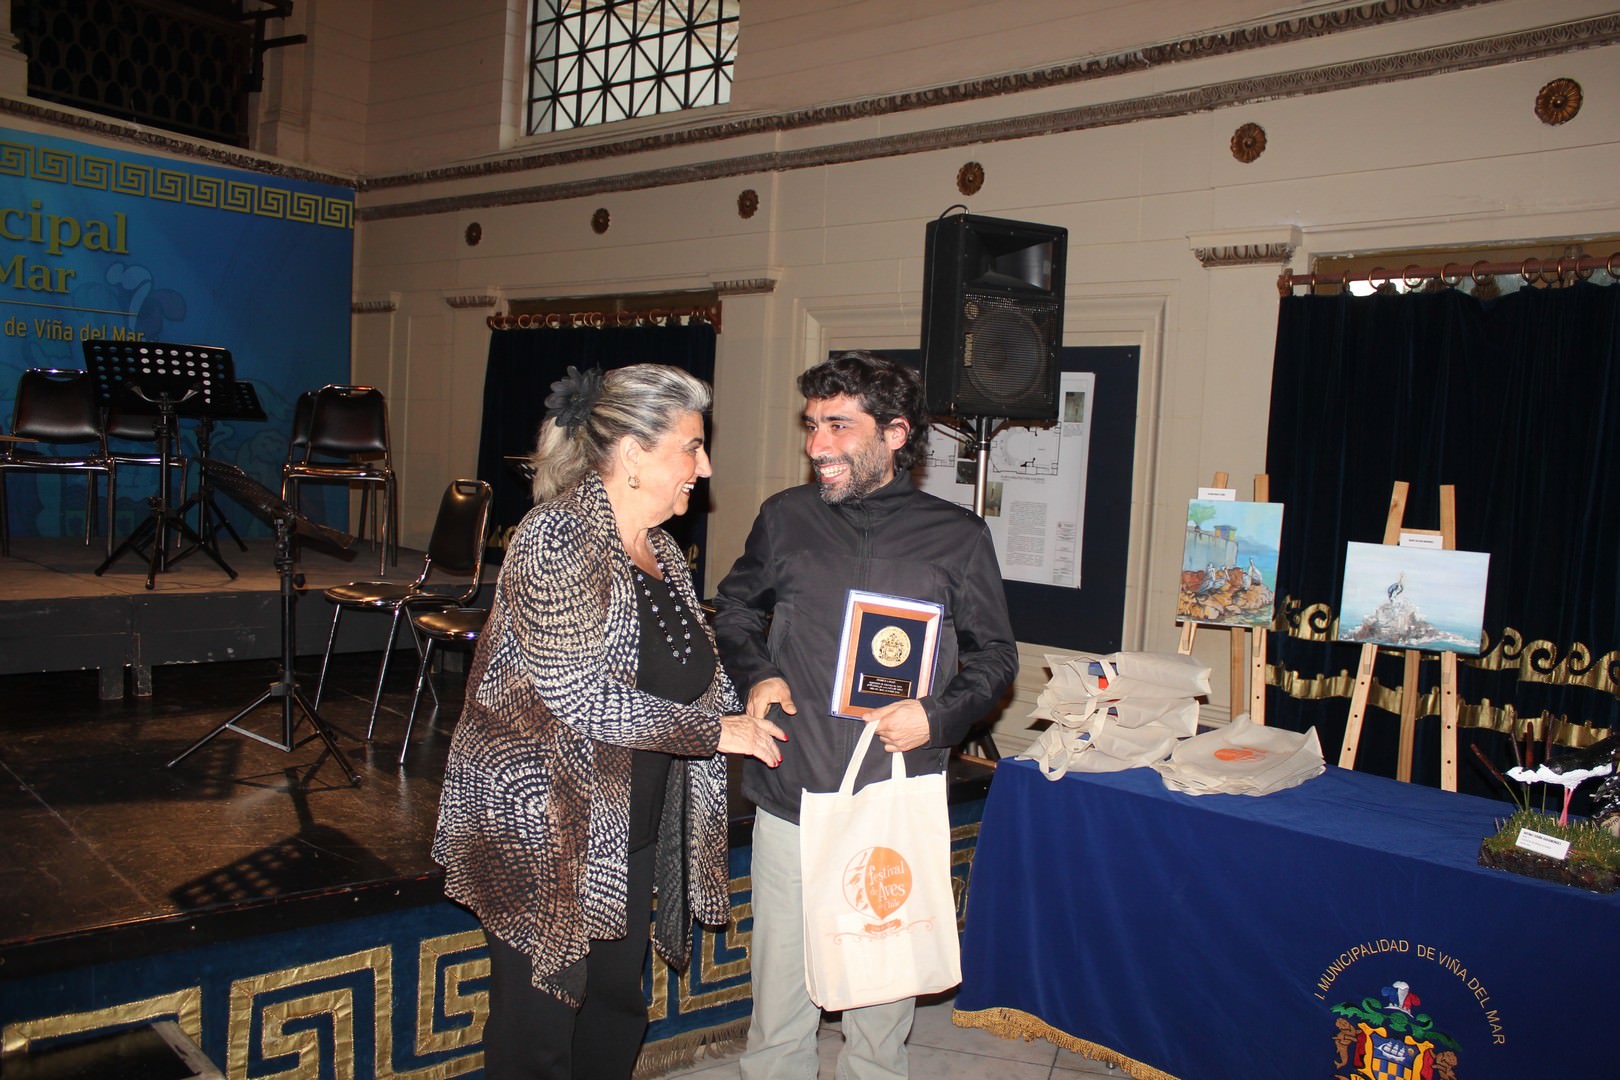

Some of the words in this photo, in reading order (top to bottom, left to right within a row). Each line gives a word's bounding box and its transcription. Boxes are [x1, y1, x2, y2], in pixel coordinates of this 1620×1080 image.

[0, 199, 128, 255] cipal
[4, 316, 27, 337] de
[34, 318, 74, 341] Viña
[80, 322, 106, 341] del
[1317, 938, 1409, 992] MUNICIPALIDAD
[1417, 944, 1436, 961] DE
[1439, 952, 1468, 982] VIÑA
[1467, 977, 1490, 1009] DEL
[1485, 1009, 1506, 1045] MAR
